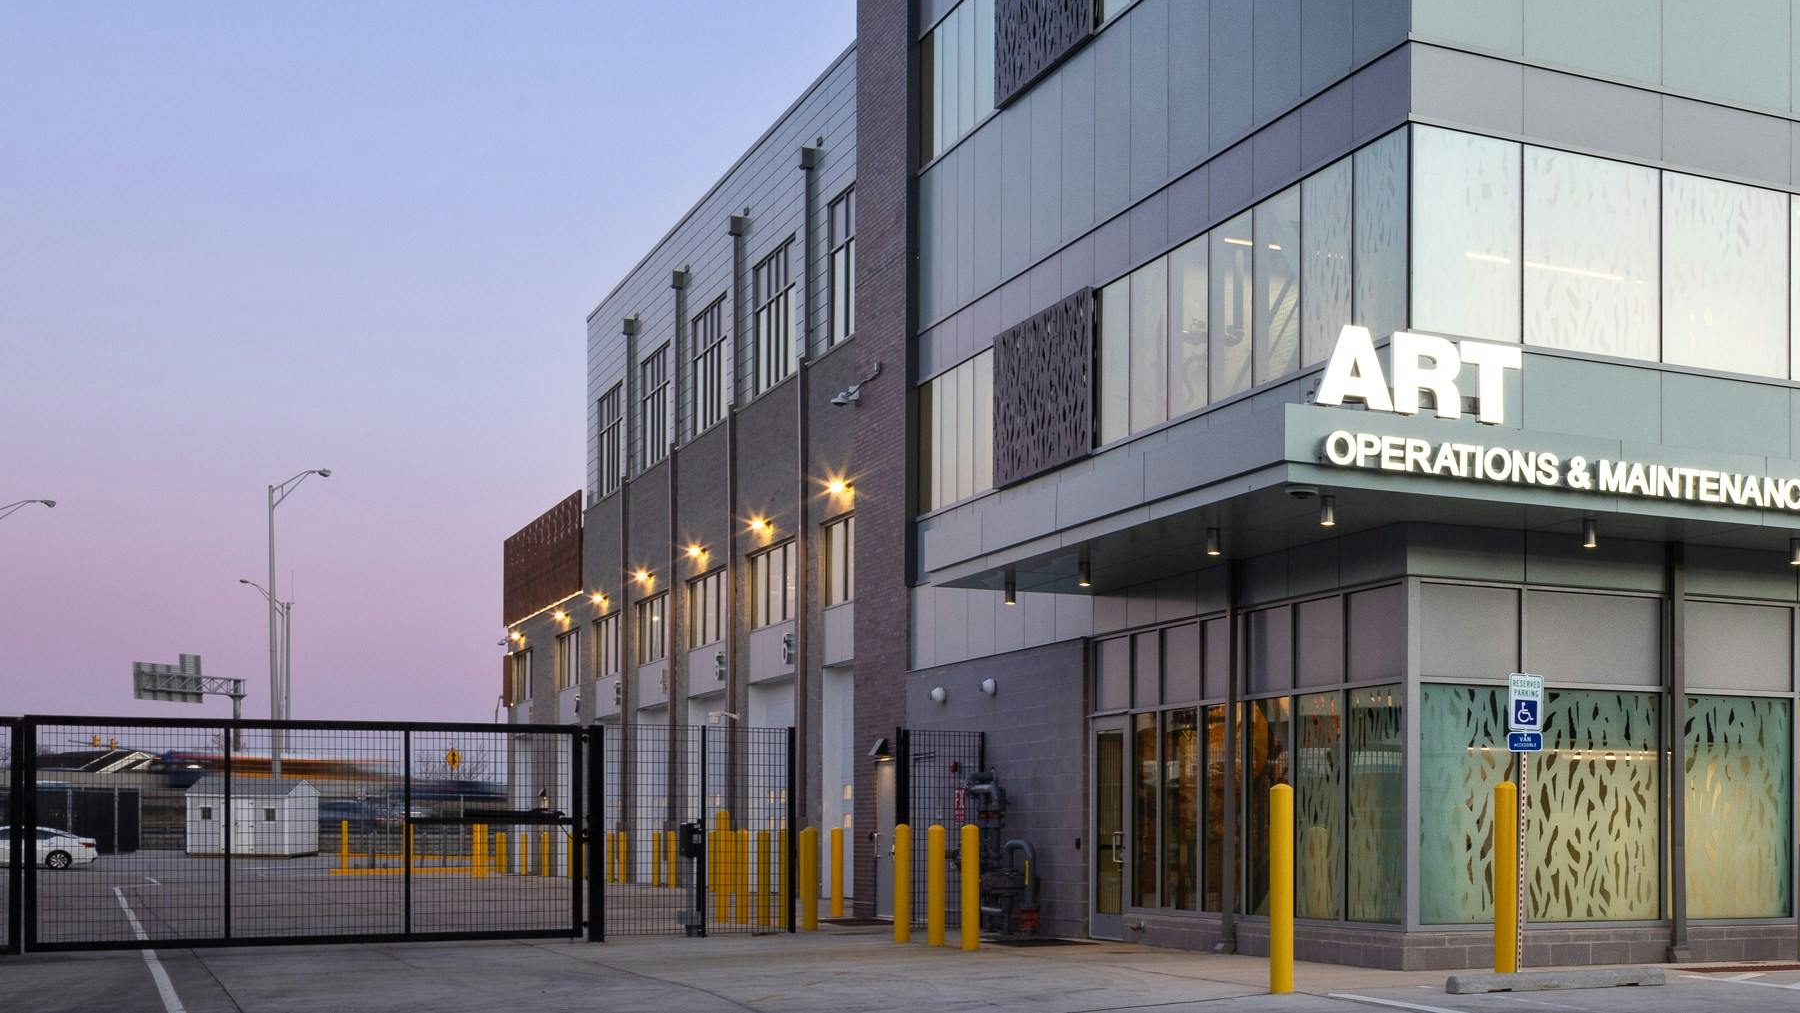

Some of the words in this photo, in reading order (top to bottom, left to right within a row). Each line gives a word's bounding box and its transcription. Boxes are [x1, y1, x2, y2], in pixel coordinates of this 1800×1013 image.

[1315, 324, 1522, 424] ART
[1326, 431, 1559, 486] OPERATIONS
[1567, 456, 1591, 490] &
[1513, 679, 1540, 689] RESERVED
[1514, 689, 1539, 698] PARKING
